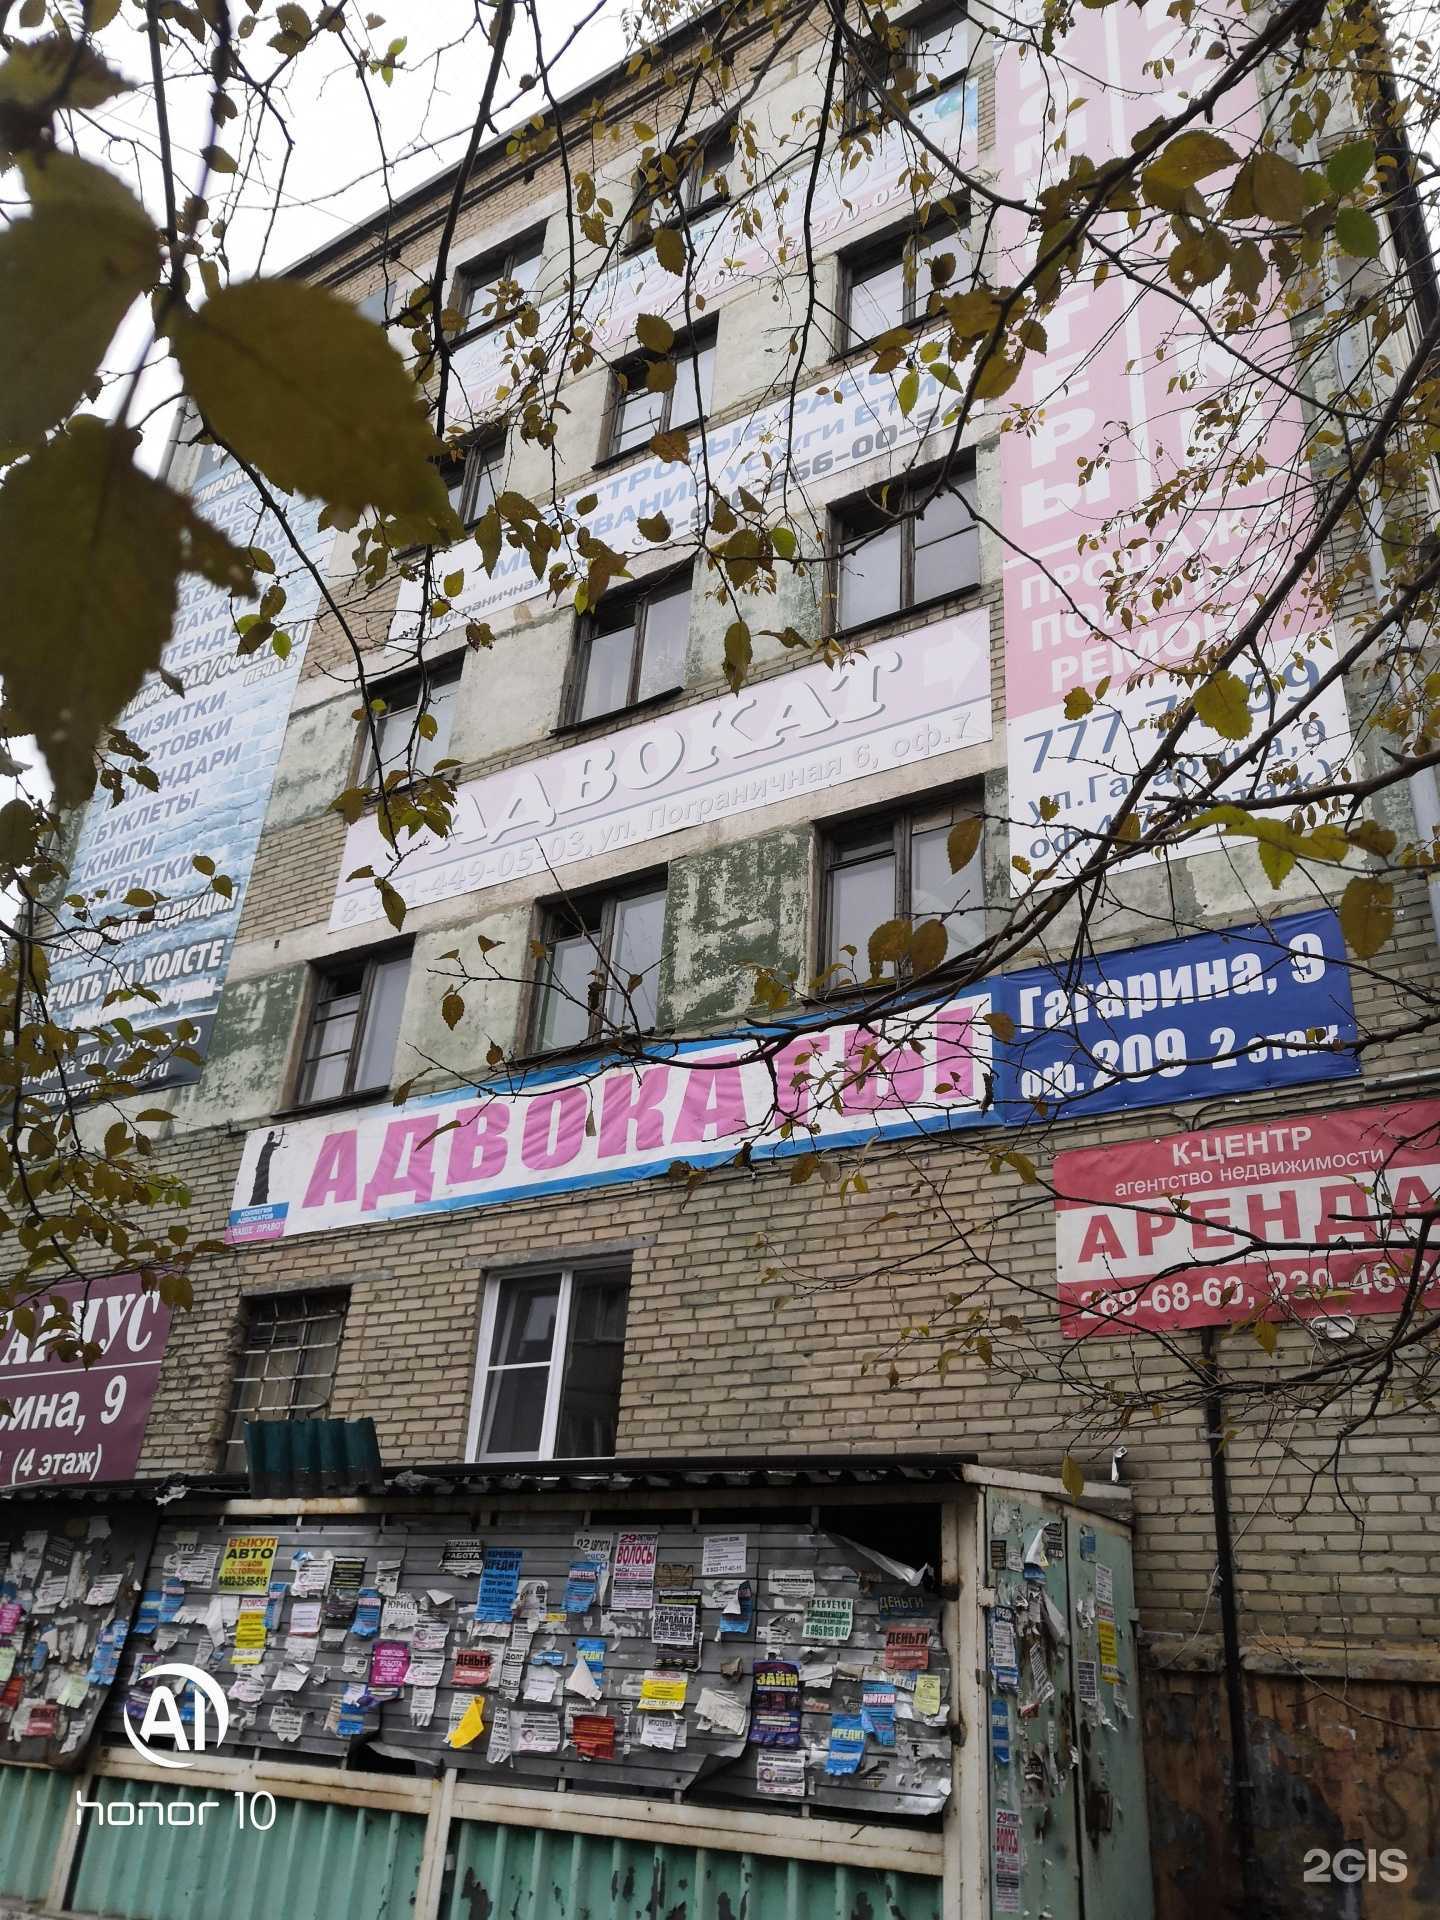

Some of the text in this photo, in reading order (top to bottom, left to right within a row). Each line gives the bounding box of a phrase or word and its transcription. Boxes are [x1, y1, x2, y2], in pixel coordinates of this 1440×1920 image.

[648, 749, 844, 834] Пограничная
[93, 788, 202, 847] БУКЛЕТЫ
[84, 834, 157, 881] КНИГИ
[139, 938, 226, 985] ХОЛСТЕ
[1018, 932, 1327, 1034] Гагарина, 9
[1020, 1061, 1086, 1099] оф.
[1093, 1027, 1188, 1088] 209
[1208, 1026, 1238, 1071] 2
[301, 1006, 975, 1211] АДВОКАТЫ
[1172, 1126, 1312, 1168] К-ЦЕНТР
[1114, 1148, 1386, 1198] агентство недвижимости
[1077, 1175, 1440, 1265] АРЕНДА
[100, 1375, 128, 1424] 9
[12, 1443, 103, 1485] (4 этаж)
[225, 1548, 274, 1560] АВТО
[886, 1631, 929, 1646] ДЕНЬГИ
